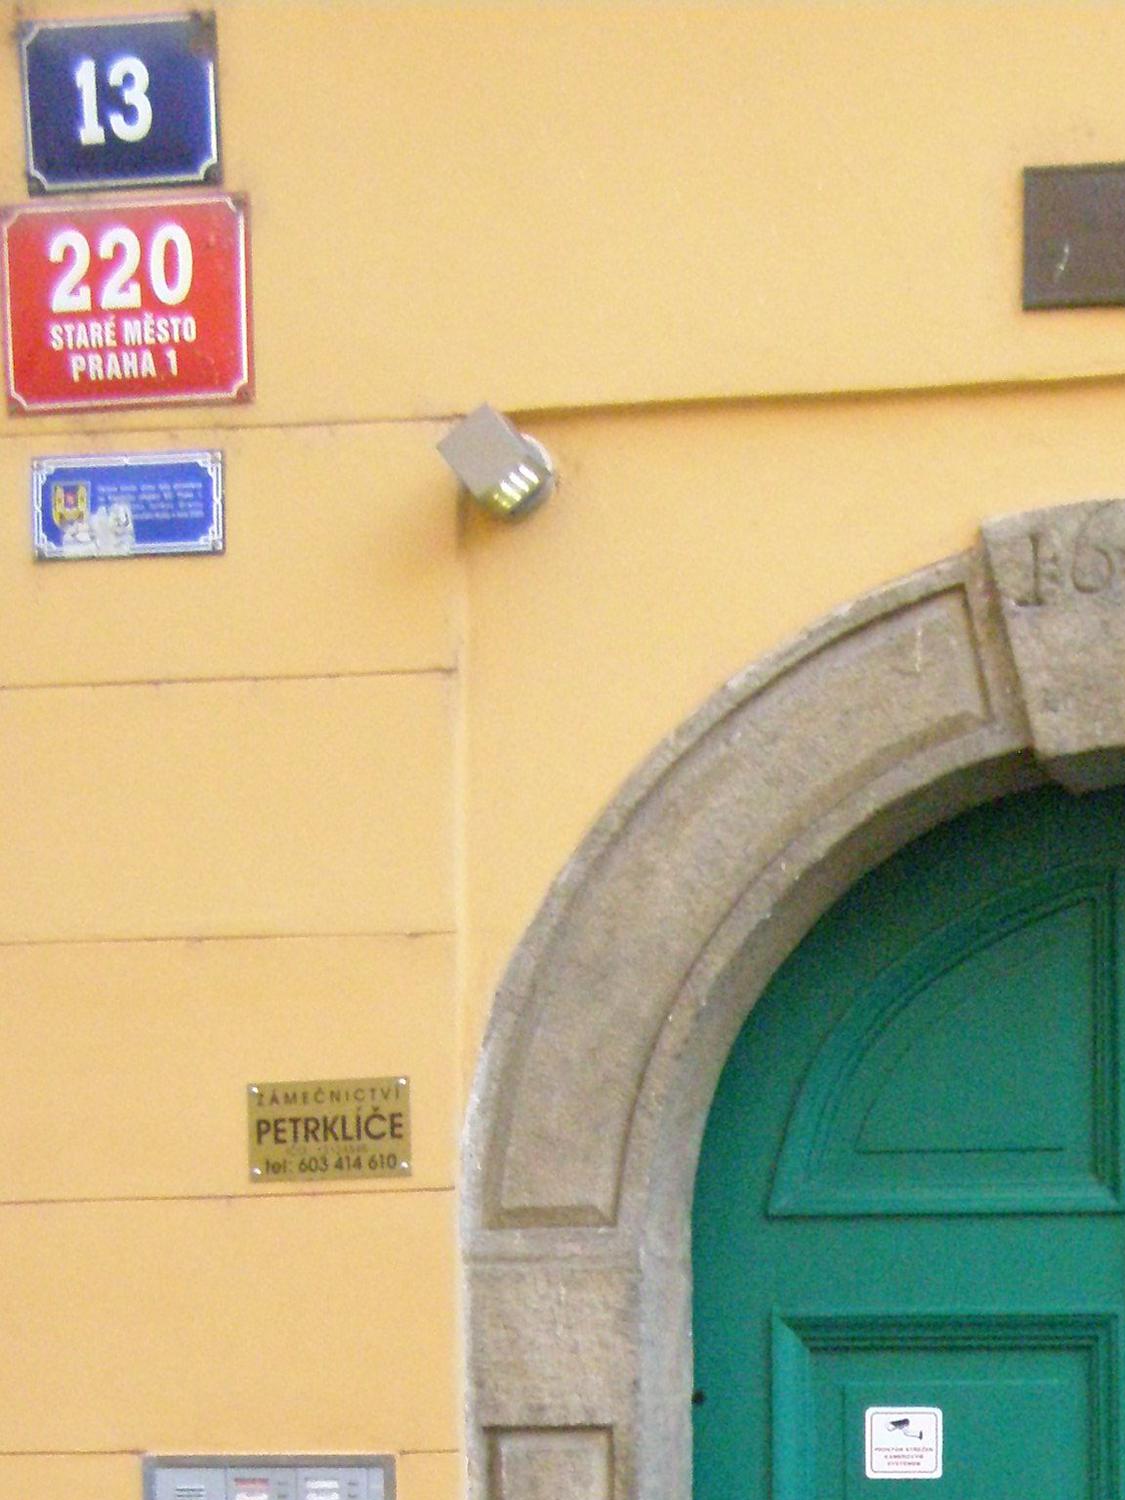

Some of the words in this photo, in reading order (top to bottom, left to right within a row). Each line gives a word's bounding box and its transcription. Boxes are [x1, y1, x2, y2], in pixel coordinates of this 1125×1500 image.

[75, 57, 153, 145] 13
[48, 222, 193, 313] 220
[48, 314, 117, 350] STARÉ
[123, 312, 197, 345] MĚSTO
[71, 352, 156, 383] PRAHA
[164, 348, 178, 376] 1
[256, 1106, 404, 1145] PETRKLÍČE
[298, 1156, 329, 1173] 603
[334, 1154, 363, 1171] 414
[368, 1152, 398, 1170] 610
